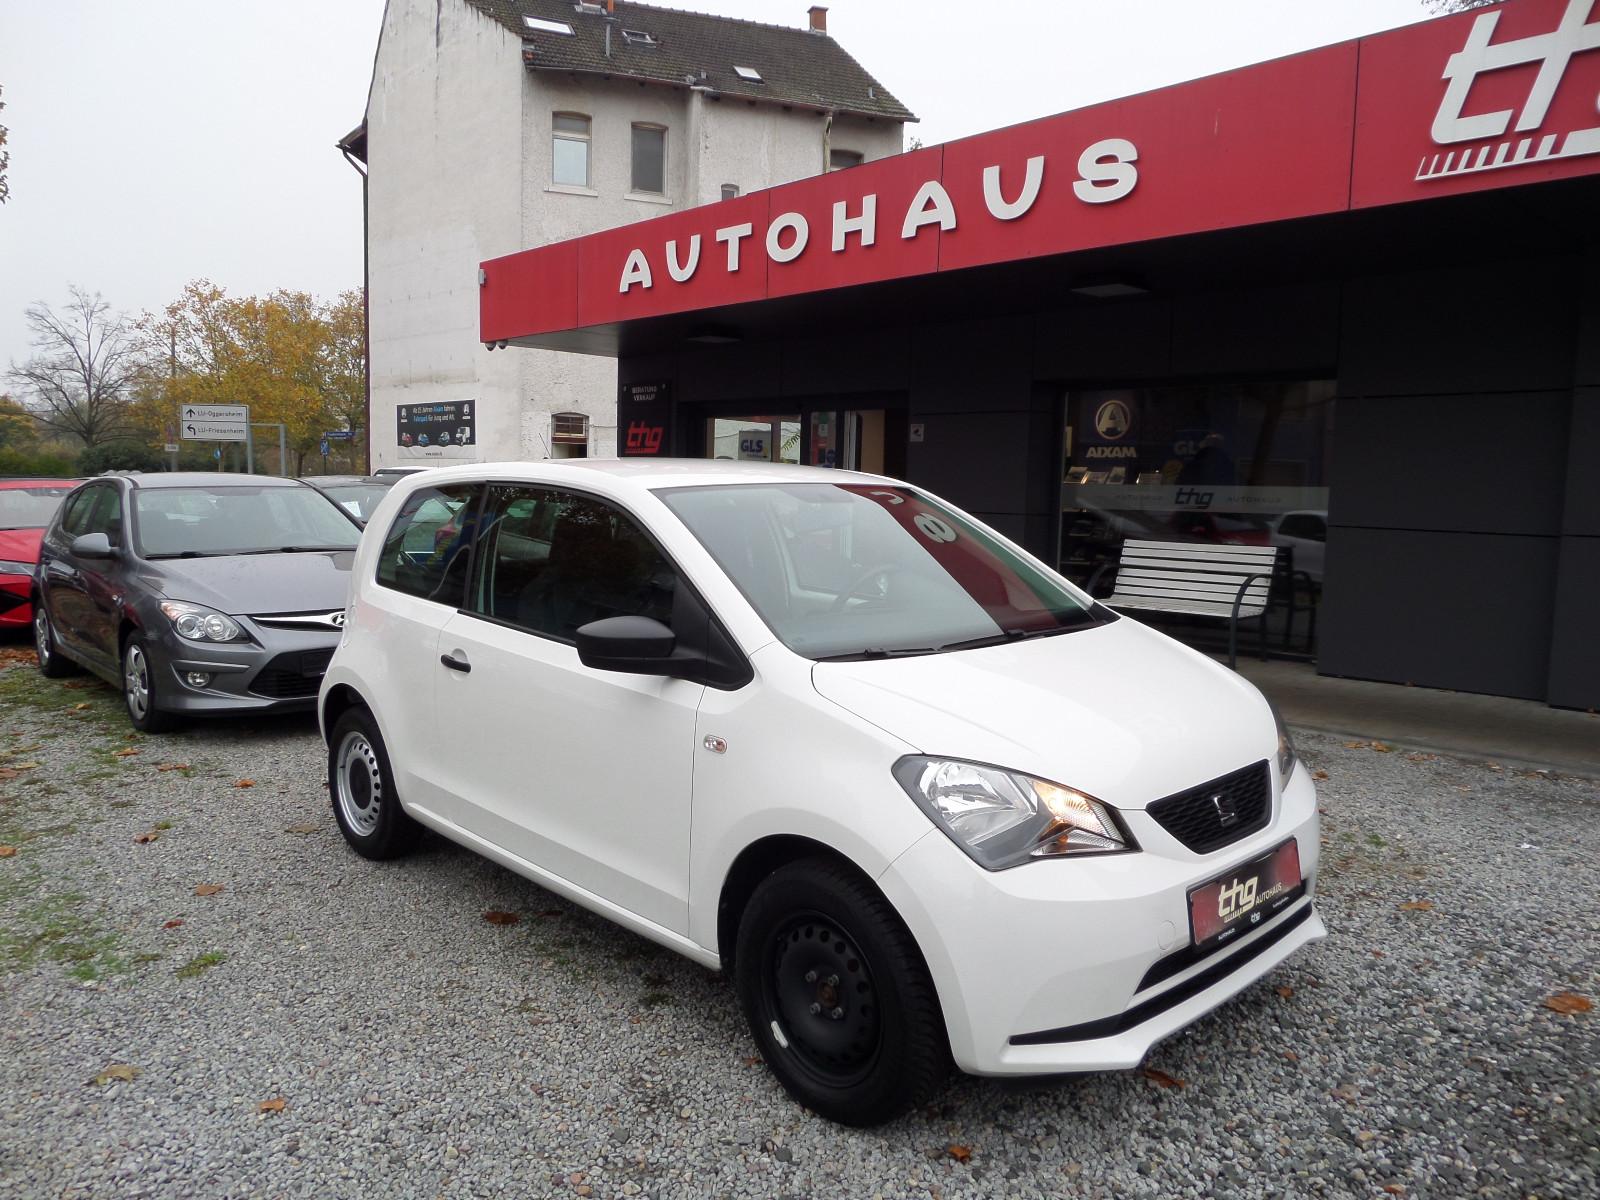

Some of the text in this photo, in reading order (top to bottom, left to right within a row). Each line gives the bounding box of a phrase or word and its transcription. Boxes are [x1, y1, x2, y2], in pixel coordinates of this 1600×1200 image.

[618, 138, 1139, 294] AUTOHAUS
[624, 420, 665, 454] thg
[741, 439, 764, 453] GLS
[1086, 446, 1137, 459] AIXAM
[1174, 486, 1214, 510] thg
[1218, 876, 1283, 923] thg AUTOHAUS
